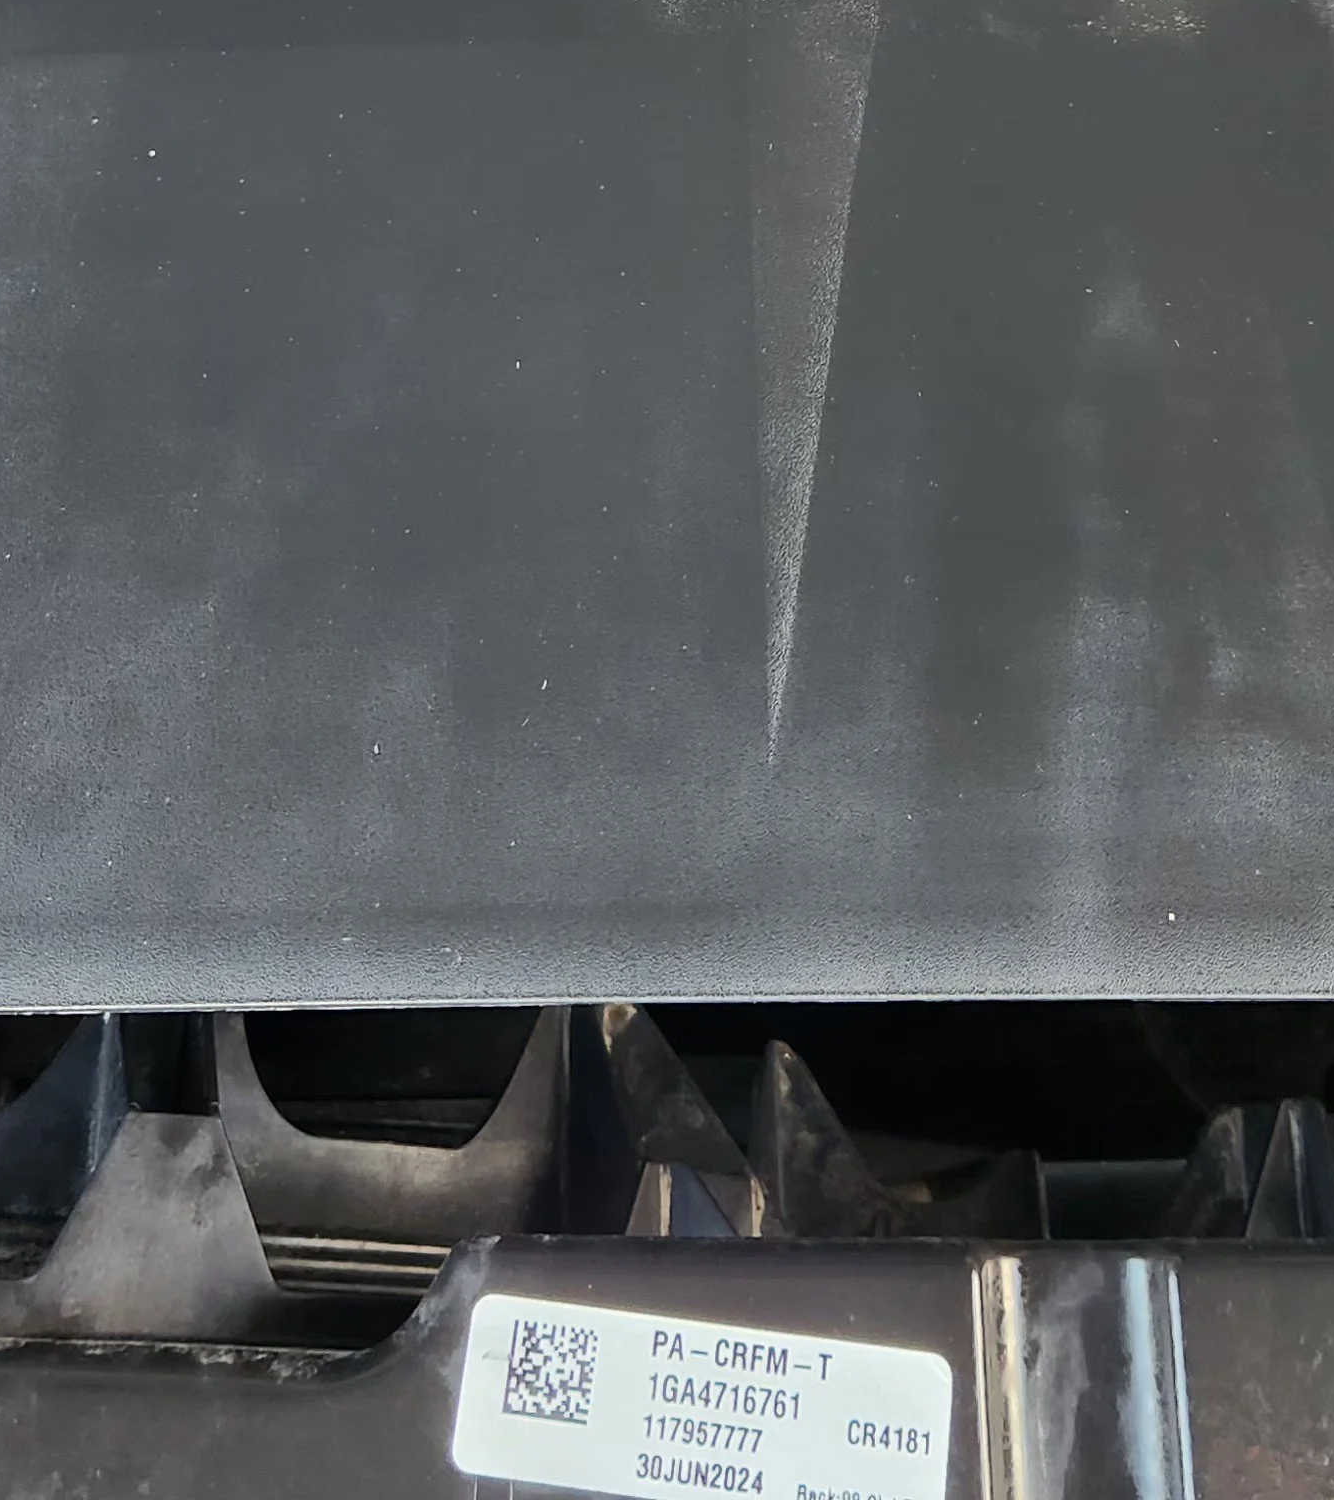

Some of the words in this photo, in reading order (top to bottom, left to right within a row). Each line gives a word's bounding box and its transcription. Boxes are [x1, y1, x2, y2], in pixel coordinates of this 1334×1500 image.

[651, 1329, 833, 1381] PA-CRFM-T
[649, 1371, 801, 1421] 1GA4716761
[642, 1413, 764, 1454] 117957777
[846, 1419, 933, 1456] CR4181
[635, 1452, 765, 1496] 30JUN2024
